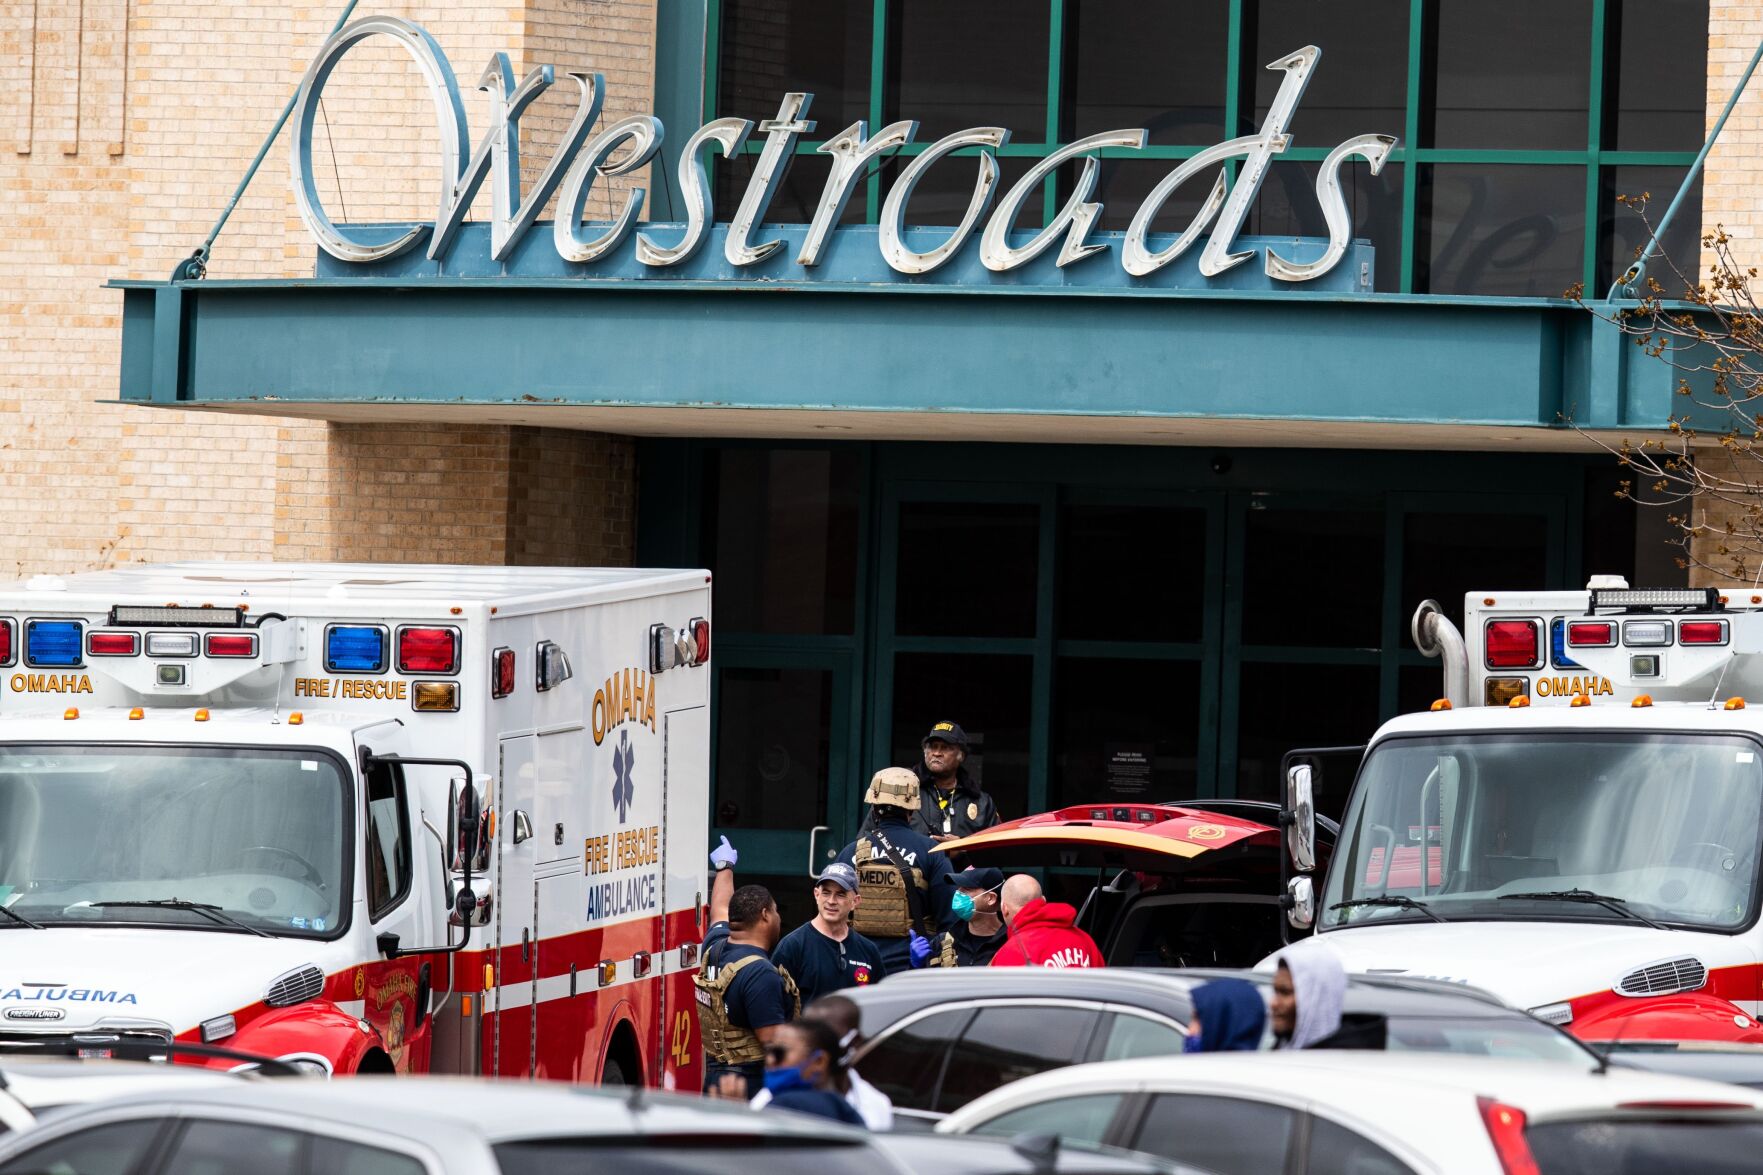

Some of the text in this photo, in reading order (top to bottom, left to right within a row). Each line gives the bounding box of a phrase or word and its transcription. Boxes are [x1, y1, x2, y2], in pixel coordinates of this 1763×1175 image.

[289, 14, 1399, 283] Westroads
[11, 673, 93, 693] OMAHA
[295, 678, 329, 697] FIRE
[342, 680, 407, 699] RESCUE
[1536, 676, 1614, 697] OMAHA
[592, 668, 656, 746] OMAHA
[585, 835, 609, 876] FIRE
[617, 826, 659, 870] RESCUE
[851, 846, 917, 866] MAHA
[859, 870, 896, 886] MEDIC
[587, 874, 656, 921] AMBULANCE
[8, 1009, 60, 1019] FREIGHTLINER
[671, 1009, 691, 1067] 42
